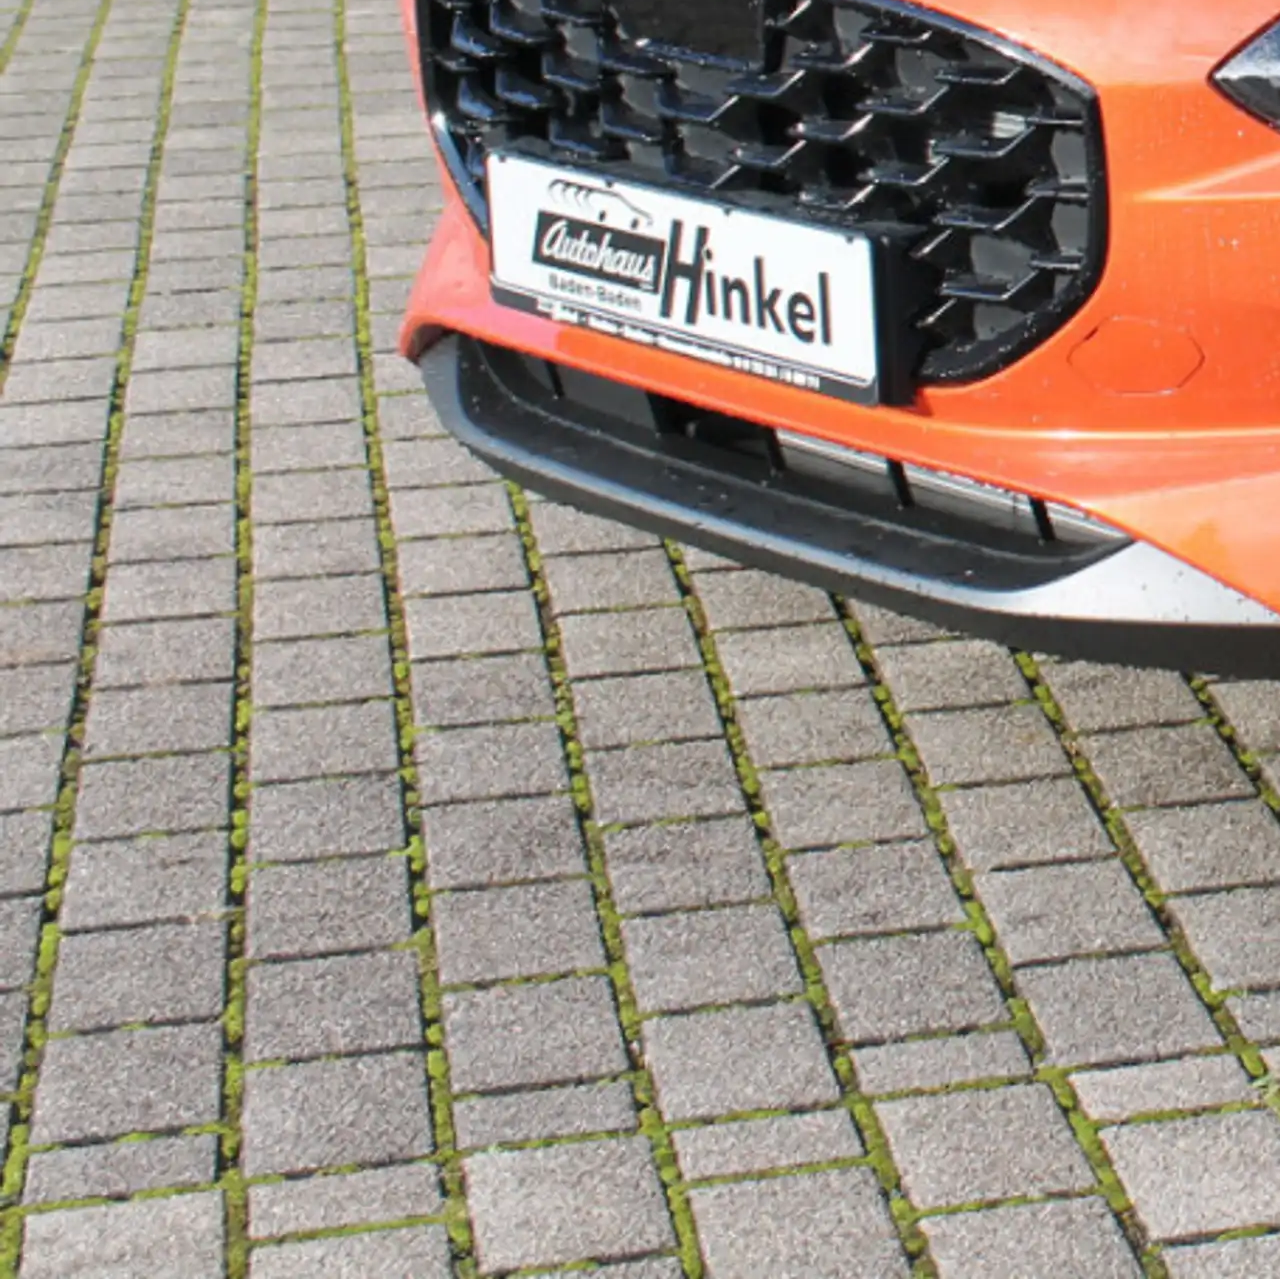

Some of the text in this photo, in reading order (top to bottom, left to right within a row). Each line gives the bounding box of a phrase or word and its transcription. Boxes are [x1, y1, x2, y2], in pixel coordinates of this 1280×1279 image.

[541, 220, 655, 281] Autohaus
[659, 219, 832, 345] Hinkel
[548, 273, 642, 312] Baden-Baden
